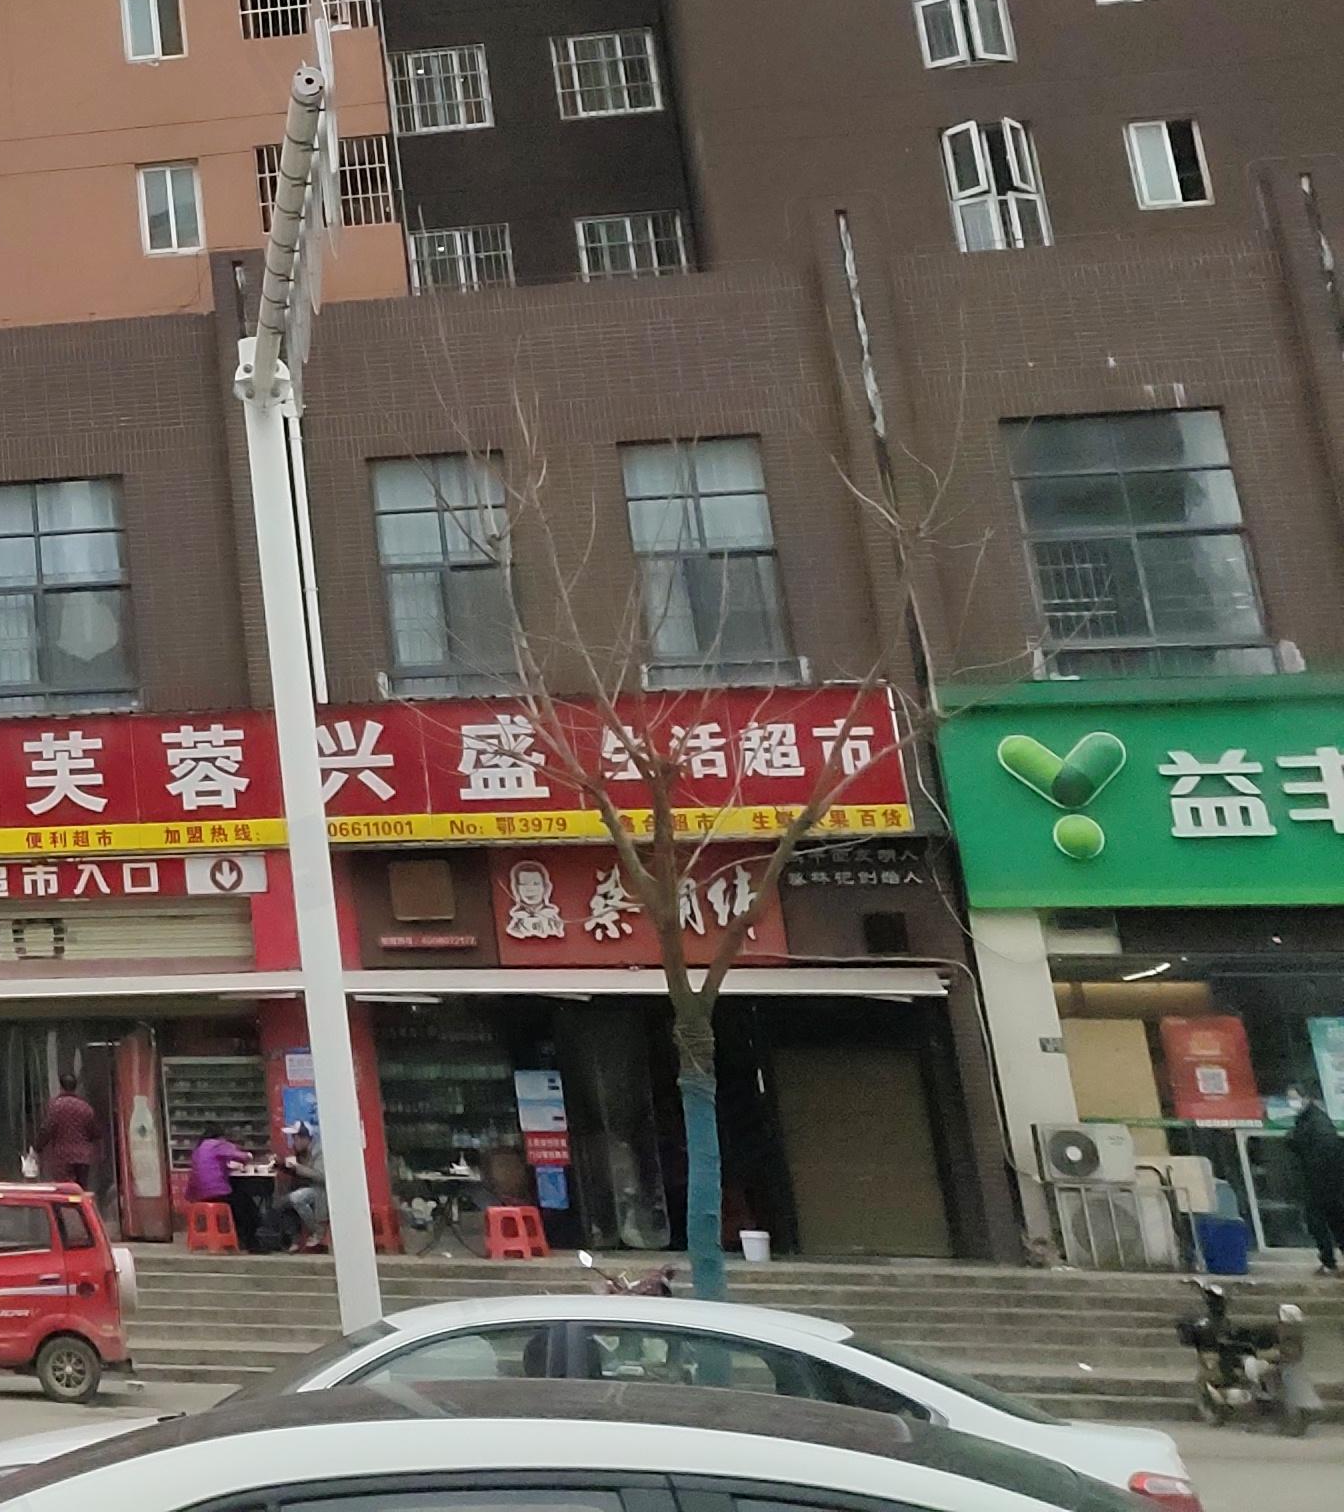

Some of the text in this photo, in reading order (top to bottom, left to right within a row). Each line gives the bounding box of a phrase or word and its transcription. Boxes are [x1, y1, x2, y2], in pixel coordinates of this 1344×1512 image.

[23, 714, 875, 816] 芙蓉兴盛 生活超市
[25, 829, 114, 849] 便利超市
[495, 817, 568, 835] 鄂3979
